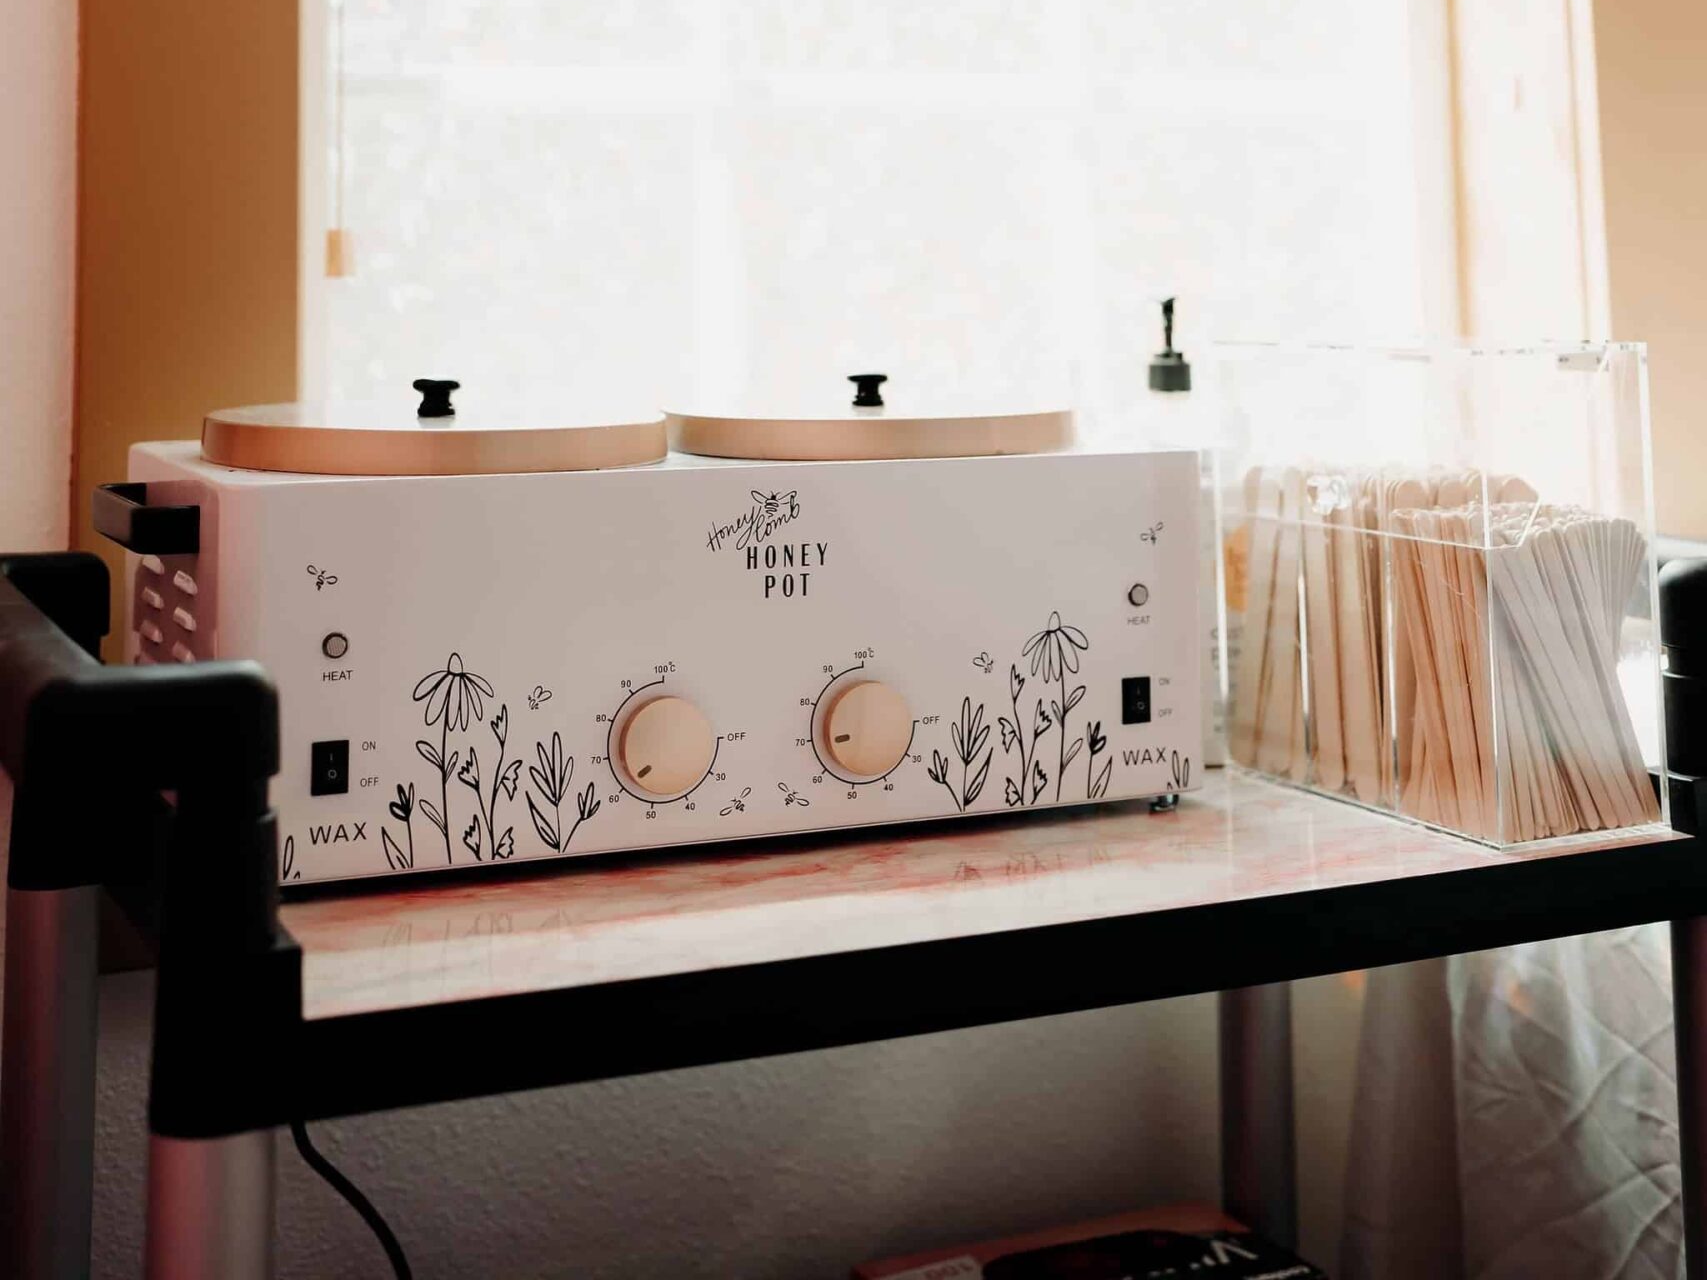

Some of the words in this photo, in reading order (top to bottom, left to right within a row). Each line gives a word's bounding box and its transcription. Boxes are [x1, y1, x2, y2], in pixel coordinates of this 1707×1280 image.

[706, 506, 762, 551] Honey
[746, 542, 828, 570] HONEY
[765, 573, 811, 599] POT
[1127, 615, 1151, 626] HEAT
[822, 665, 833, 673] 90
[322, 670, 353, 682] HEAT
[620, 679, 632, 689] 90
[1158, 677, 1171, 686] ON
[799, 698, 810, 706] 80
[1158, 709, 1173, 718] OFF
[595, 714, 607, 723] 80
[922, 716, 940, 725] OFF
[727, 732, 747, 742] OFF
[361, 741, 377, 751] ON
[795, 738, 806, 747] 70
[590, 756, 602, 765] 70
[912, 754, 922, 763] 30
[1122, 746, 1167, 767] WAX
[715, 773, 726, 781] 30
[812, 775, 823, 784] 60
[360, 777, 379, 788] OFF
[883, 783, 894, 792] 40
[608, 794, 620, 804] 60
[847, 791, 858, 800] 50
[685, 802, 696, 811] 40
[646, 811, 657, 820] 50
[309, 821, 368, 846] WAX
